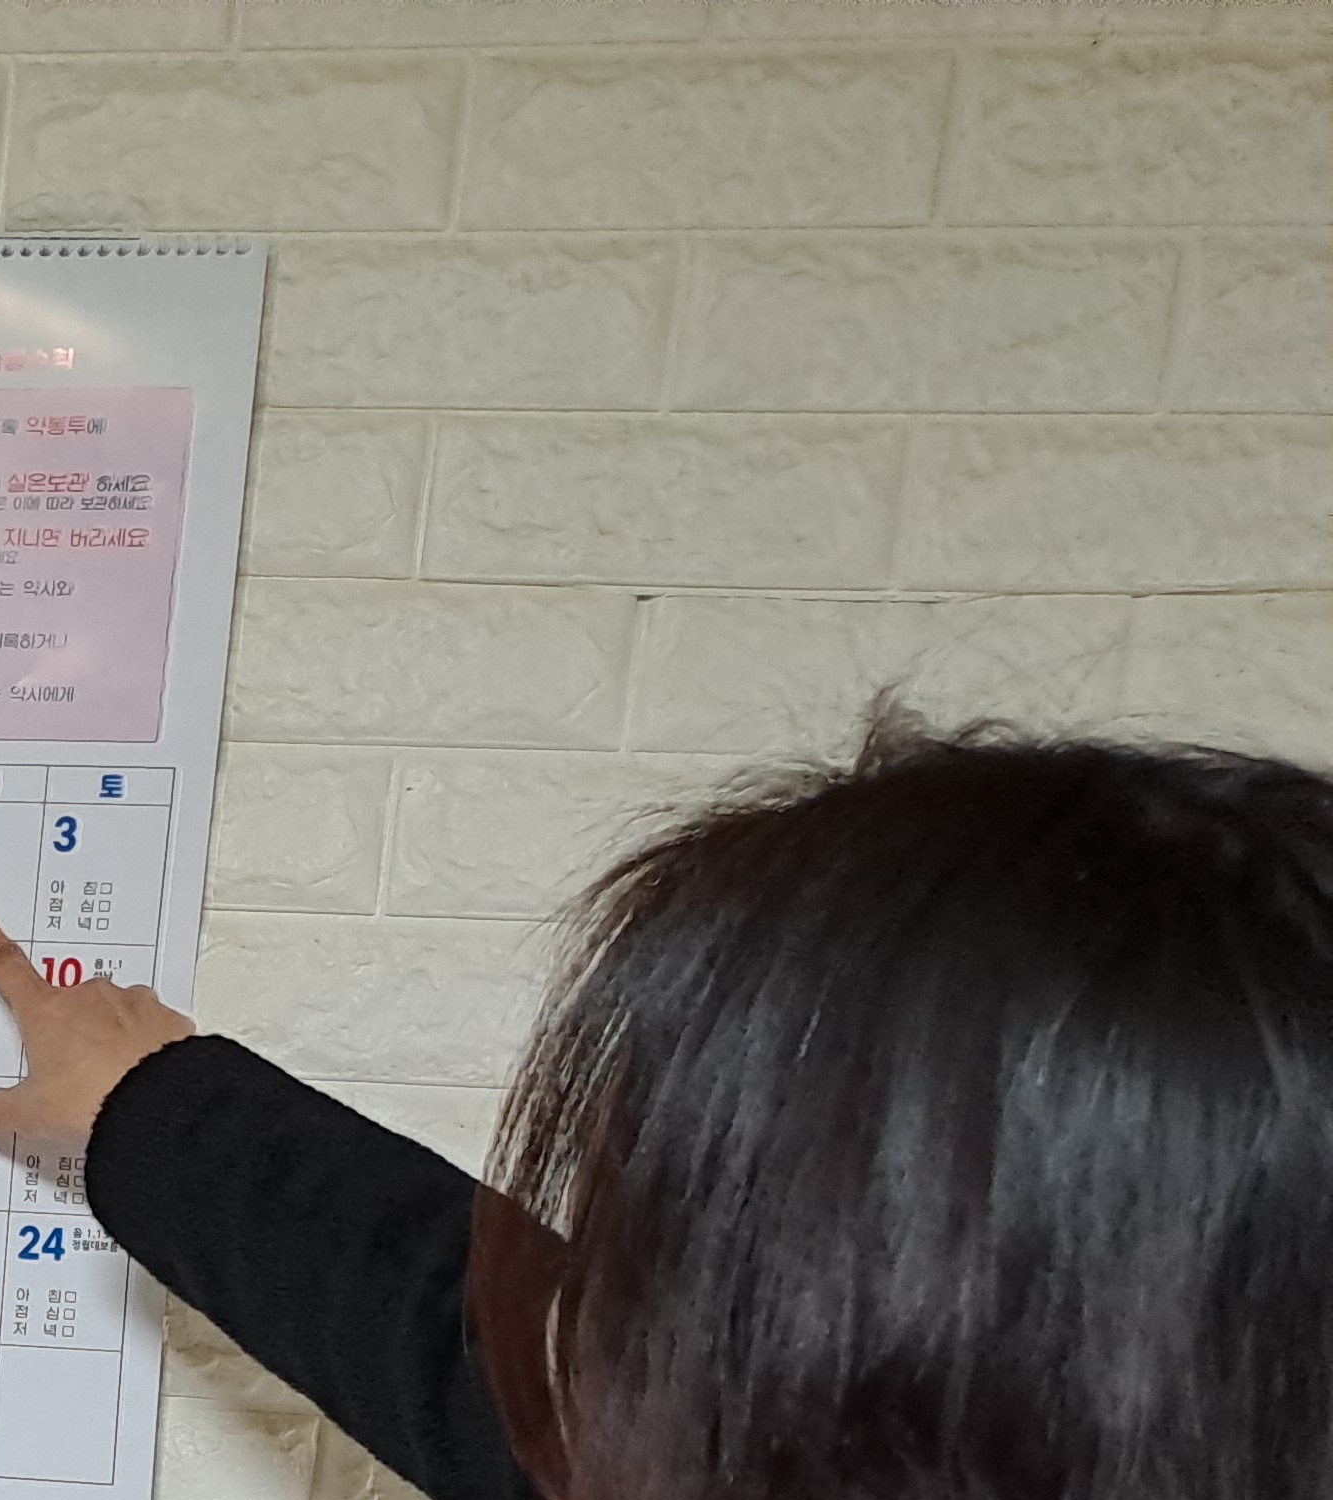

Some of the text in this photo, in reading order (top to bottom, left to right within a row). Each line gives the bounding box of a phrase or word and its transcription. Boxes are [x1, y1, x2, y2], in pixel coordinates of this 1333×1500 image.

[26, 416, 108, 436] 약봉투에
[8, 472, 90, 493] 실온보관
[46, 496, 74, 510] 따라
[4, 527, 62, 547] 지나면
[23, 580, 75, 597] 약사와
[10, 685, 74, 703] 약사에게
[99, 774, 124, 798] 토
[53, 816, 77, 852] 3
[42, 957, 82, 987] 10
[18, 1225, 65, 1261] 24
